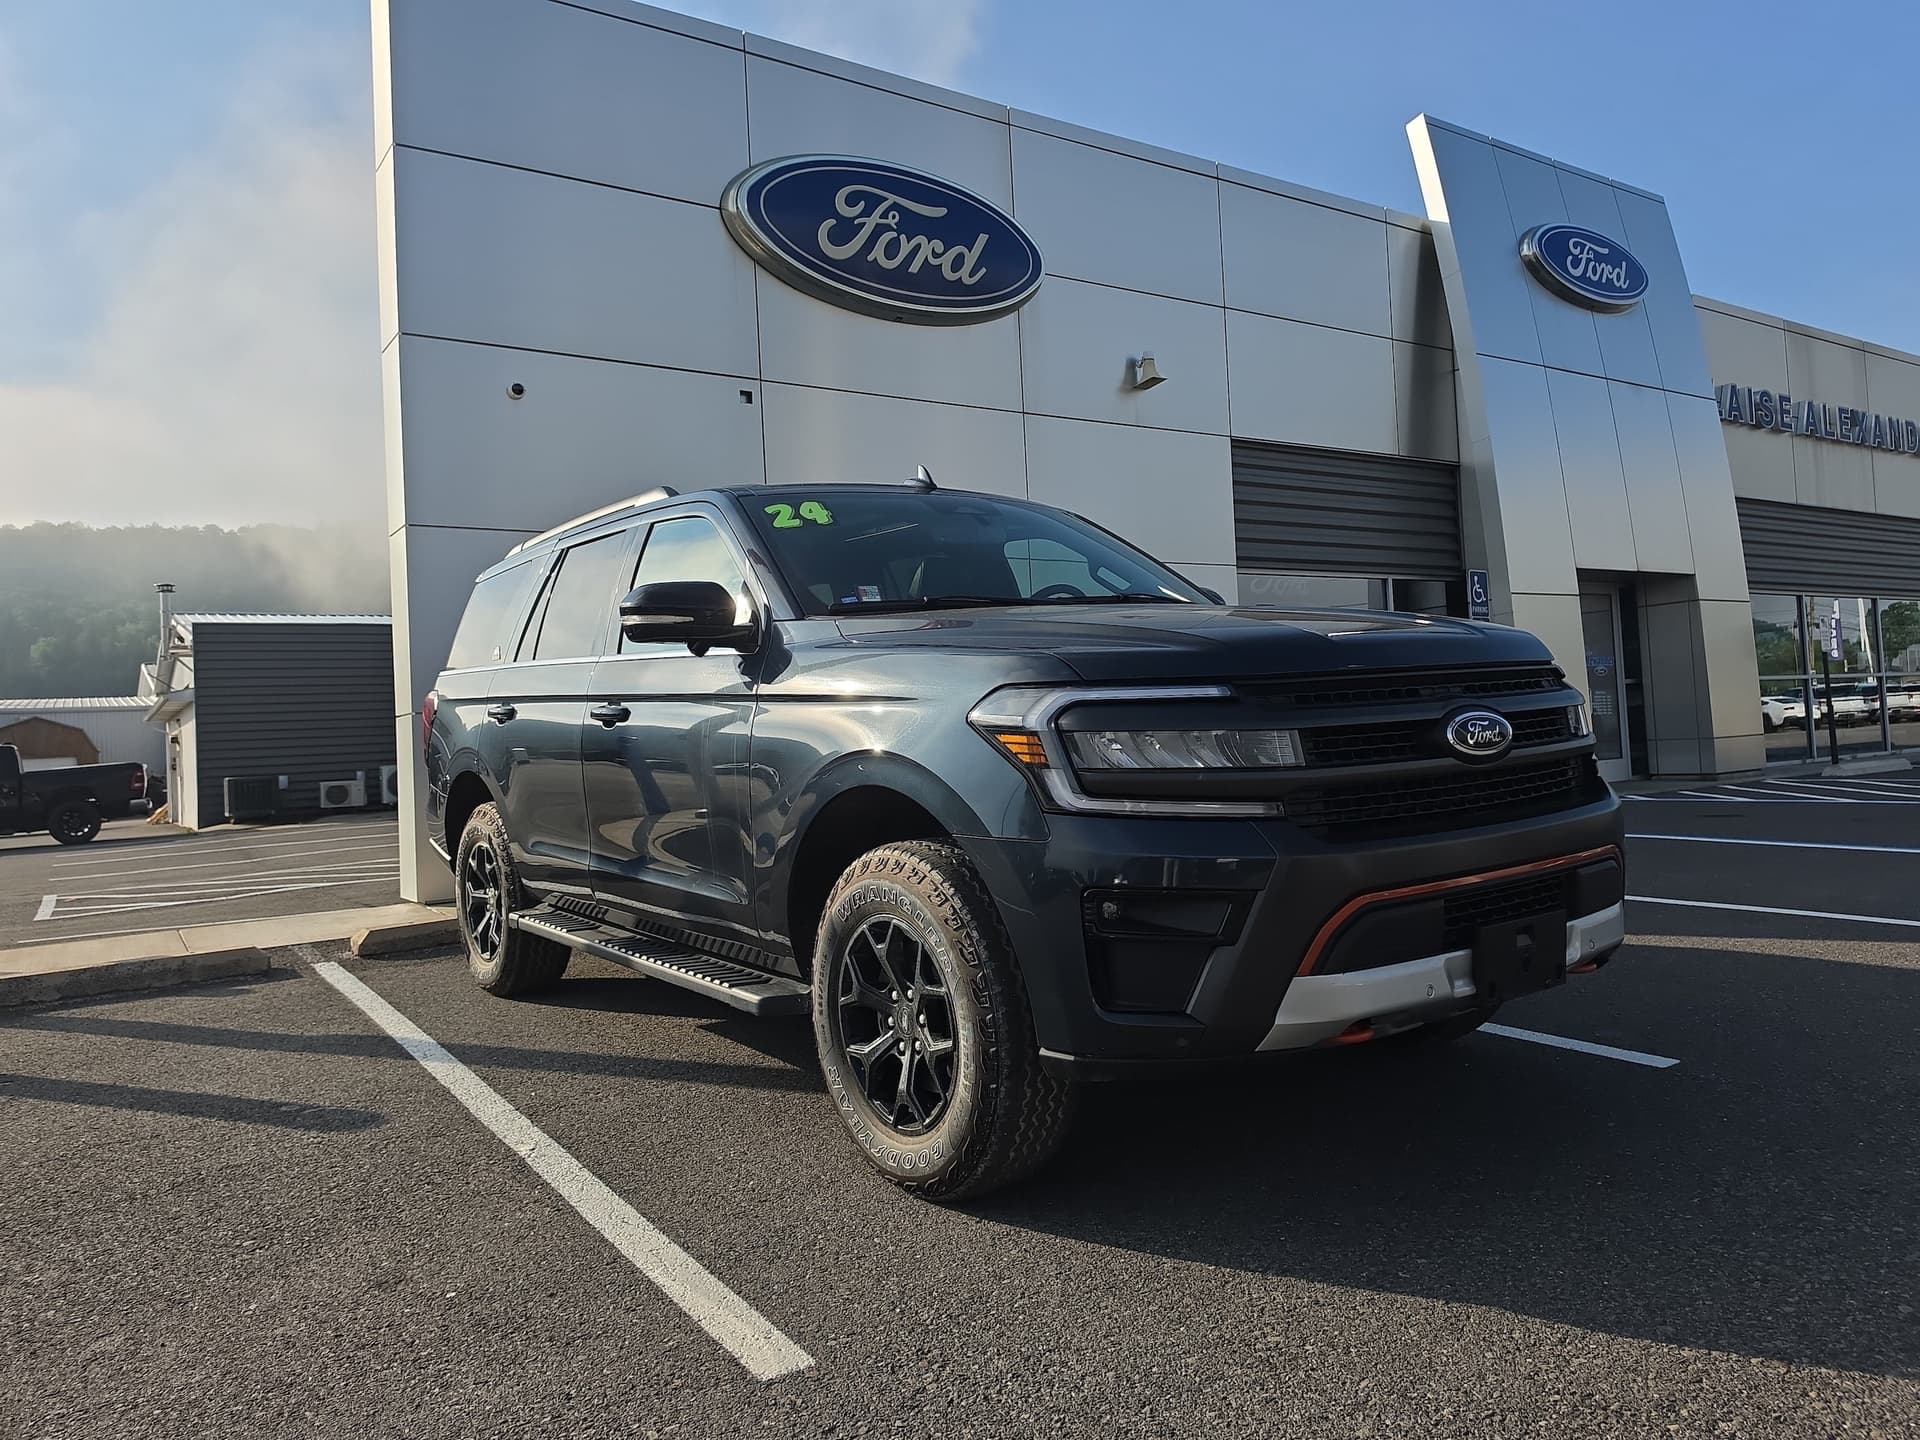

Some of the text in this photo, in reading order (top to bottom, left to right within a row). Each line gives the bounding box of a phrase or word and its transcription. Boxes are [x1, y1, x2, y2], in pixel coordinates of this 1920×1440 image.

[818, 185, 989, 285] Ford
[1567, 238, 1629, 288] Ford
[1716, 383, 1796, 432] AISE
[764, 501, 833, 526] 24
[1467, 720, 1502, 745] Ford
[836, 885, 953, 973] WRANGLER
[827, 1065, 944, 1169] GOODYEAR
